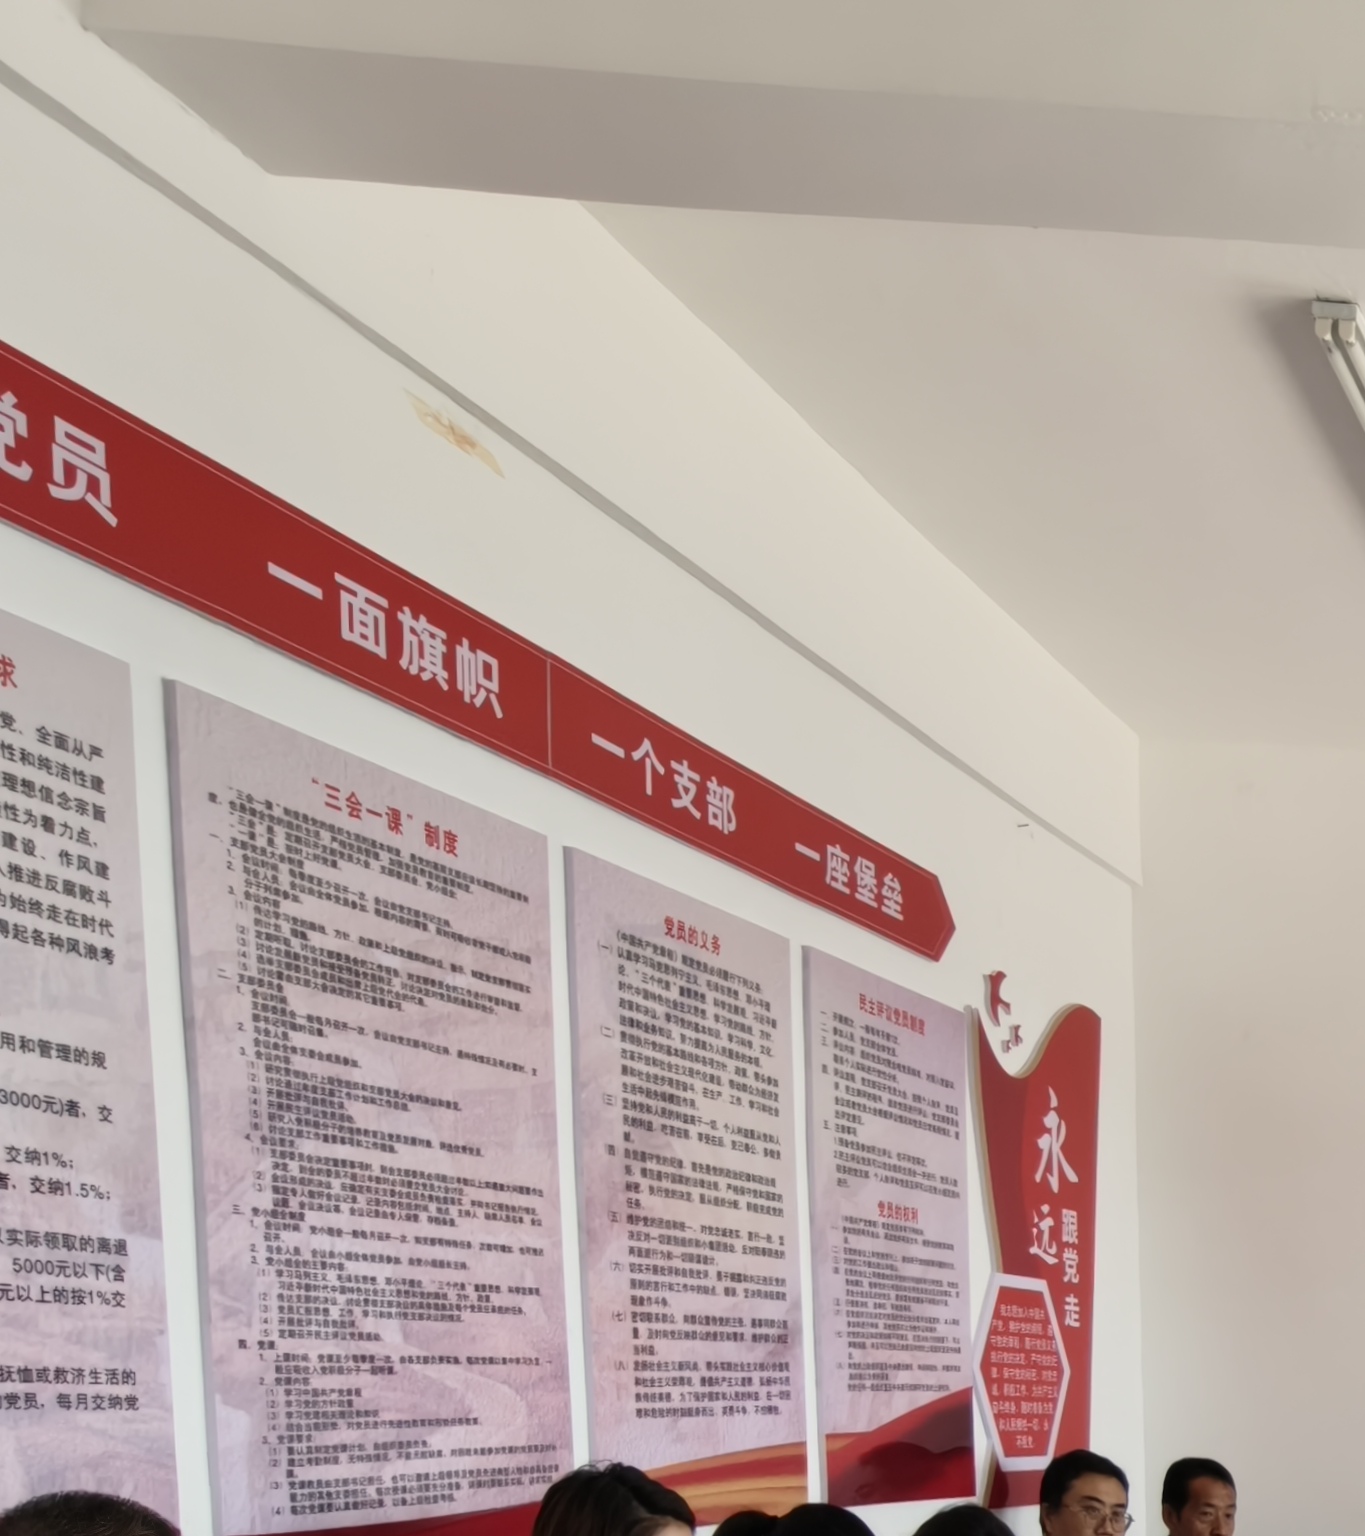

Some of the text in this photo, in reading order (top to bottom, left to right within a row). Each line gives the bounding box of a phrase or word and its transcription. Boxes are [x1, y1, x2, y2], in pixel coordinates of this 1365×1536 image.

[0, 391, 904, 920] 党员 一面旗帜 一个支部 一座堡垒
[0, 804, 98, 848] 性为着力点，
[310, 774, 460, 860] “三会一课”制度
[0, 862, 111, 908] 推进反腐败斗
[663, 913, 721, 957] 党员的义务
[1029, 1085, 1079, 1265] 永远
[0, 1228, 128, 1256] 实际领取的离退
[1061, 1208, 1080, 1328] 跟党走
[0, 1392, 139, 1411] 党员，每月交纳党
